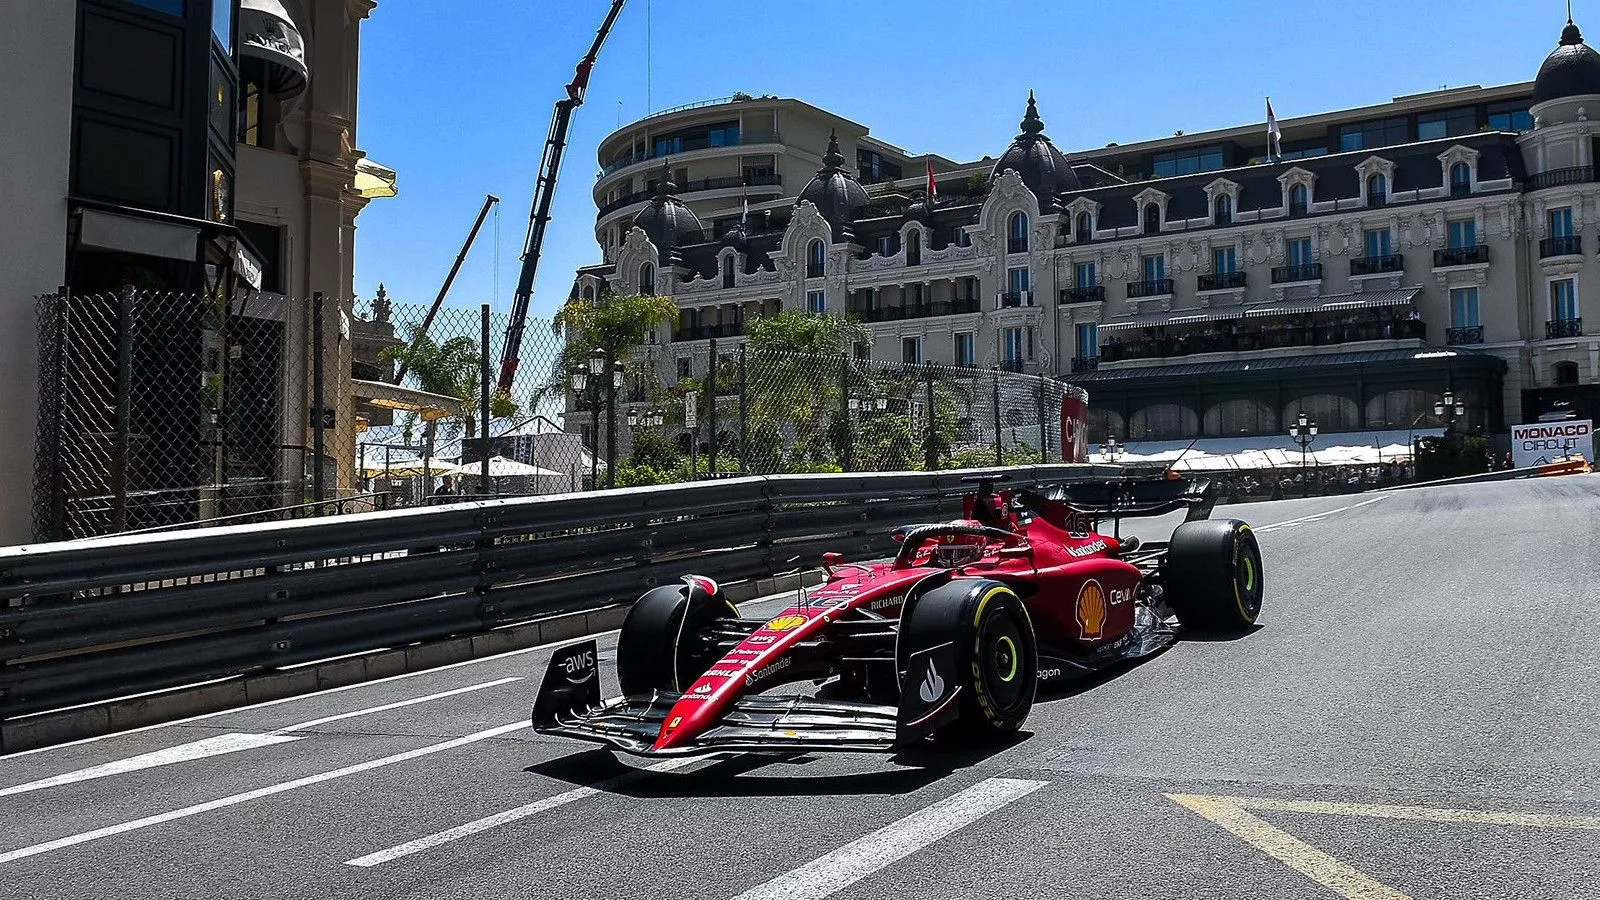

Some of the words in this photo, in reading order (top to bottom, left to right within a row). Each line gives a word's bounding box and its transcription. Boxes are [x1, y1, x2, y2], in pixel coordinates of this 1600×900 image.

[1514, 424, 1589, 439] MONACO
[1523, 437, 1580, 451] CIRCUIT
[1065, 511, 1090, 539] 16
[870, 595, 904, 610] RICHARD
[565, 650, 594, 673] aws
[752, 656, 792, 682] Santander
